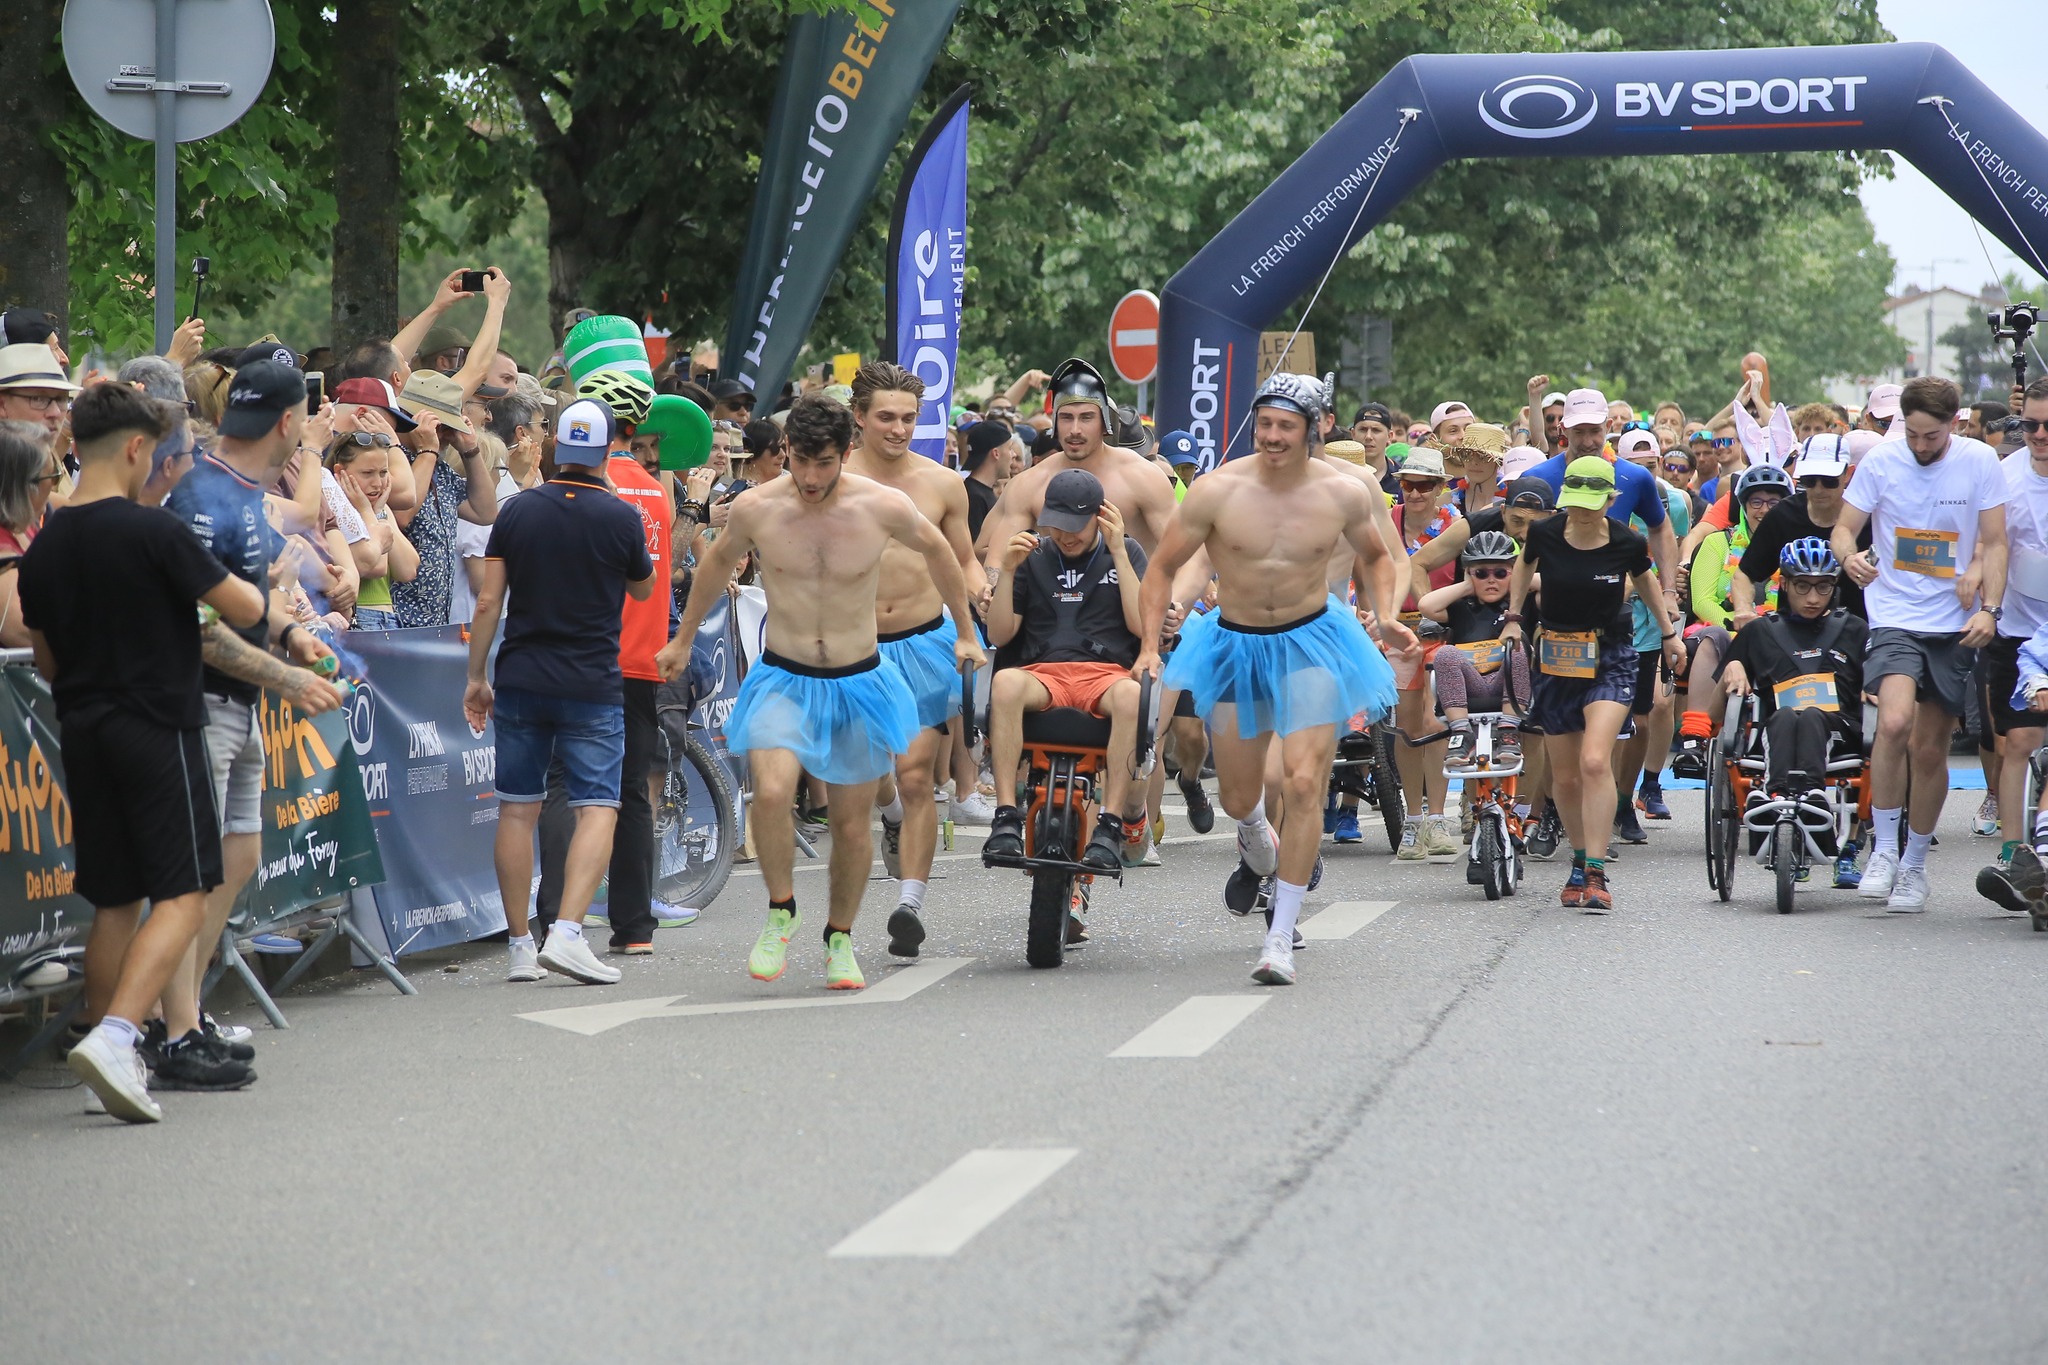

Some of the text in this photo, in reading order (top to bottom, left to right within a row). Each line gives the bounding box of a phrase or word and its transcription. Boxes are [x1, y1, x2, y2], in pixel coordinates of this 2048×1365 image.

[1615, 76, 1868, 117] BV SPORT
[1948, 122, 1970, 143] LA
[1968, 139, 2027, 192] FRENCH
[1231, 137, 1400, 297] LA FRENCH PERFORMANCE
[1189, 337, 1221, 473] SPORT
[1915, 545, 1938, 556] 617
[1795, 687, 1817, 699] 653
[359, 762, 389, 801] ORT
[407, 763, 448, 796] PERFORMANCE
[462, 750, 476, 786] BV
[276, 804, 287, 829] De
[286, 800, 299, 826] la
[26, 870, 42, 900] De
[42, 867, 54, 897] la
[412, 905, 435, 927] FRENCH
